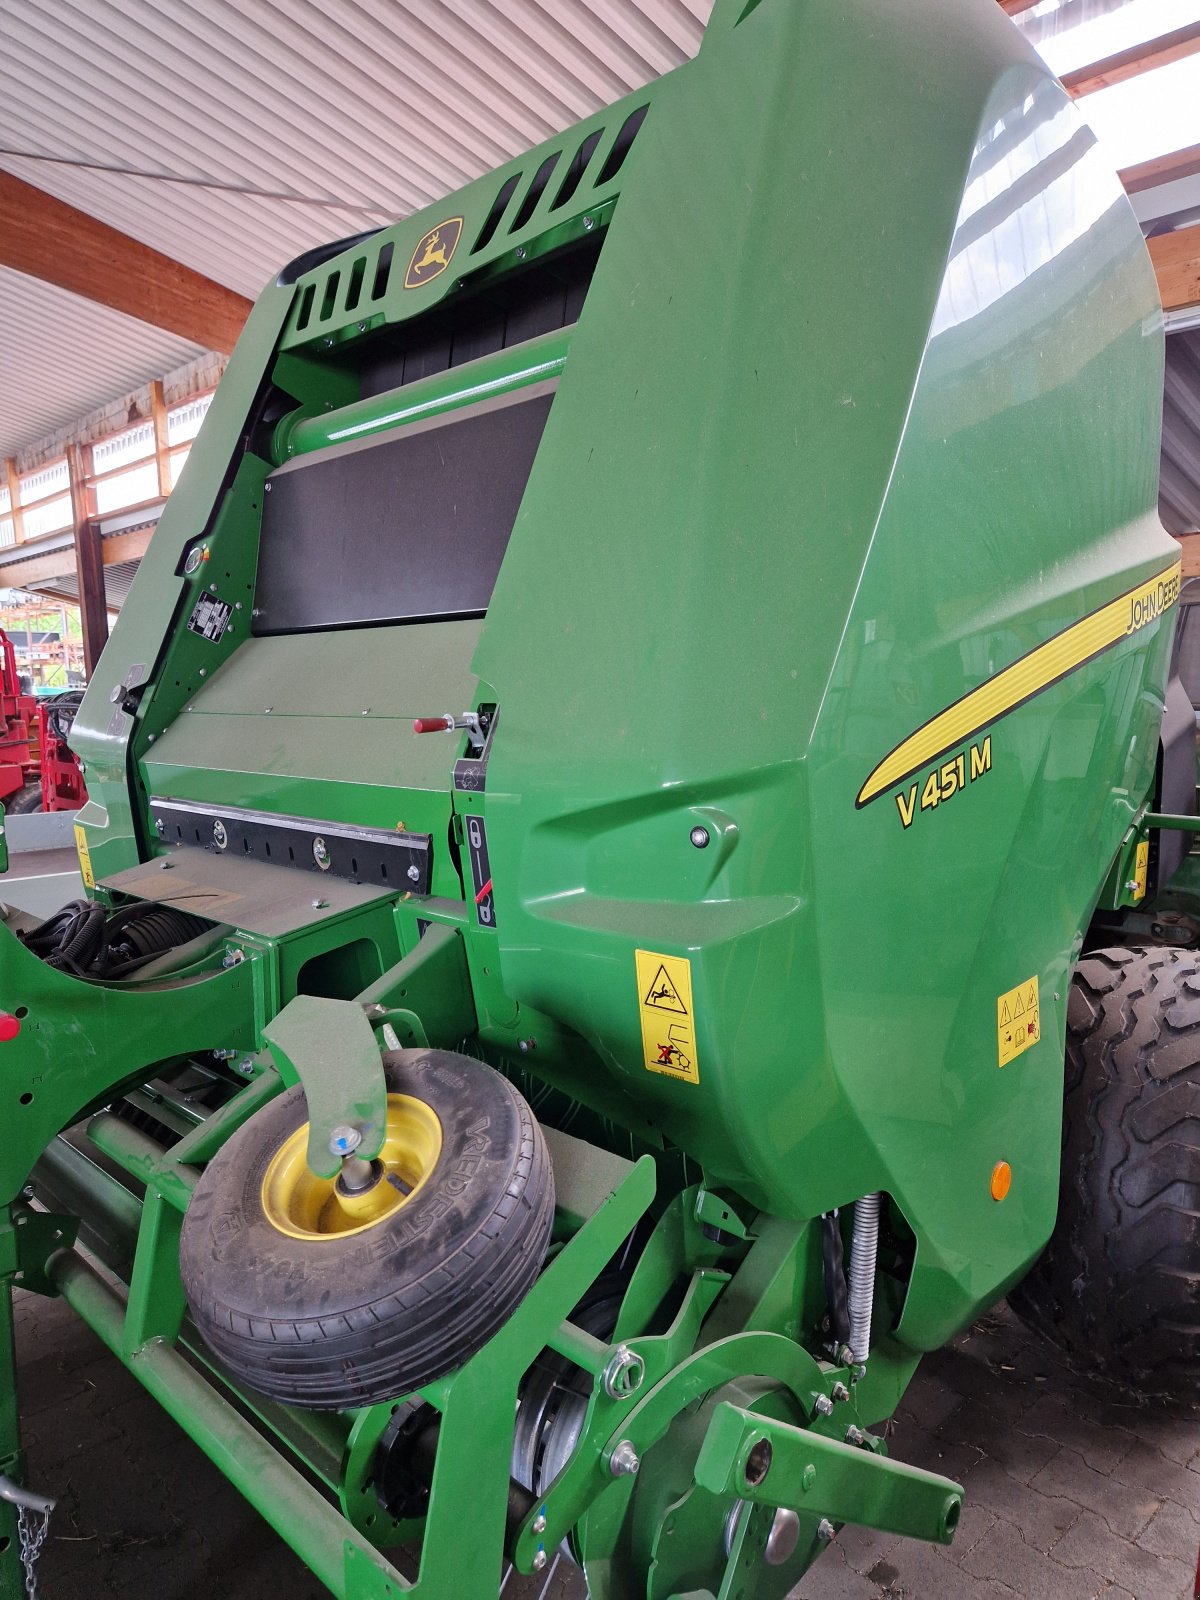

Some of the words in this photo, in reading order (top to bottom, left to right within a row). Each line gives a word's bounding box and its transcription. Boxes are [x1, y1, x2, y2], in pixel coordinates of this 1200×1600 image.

[1126, 591, 1156, 634] JOHN
[1157, 574, 1179, 611] DEERE
[894, 781, 919, 830] V
[920, 751, 966, 813] 451
[969, 733, 992, 783] M
